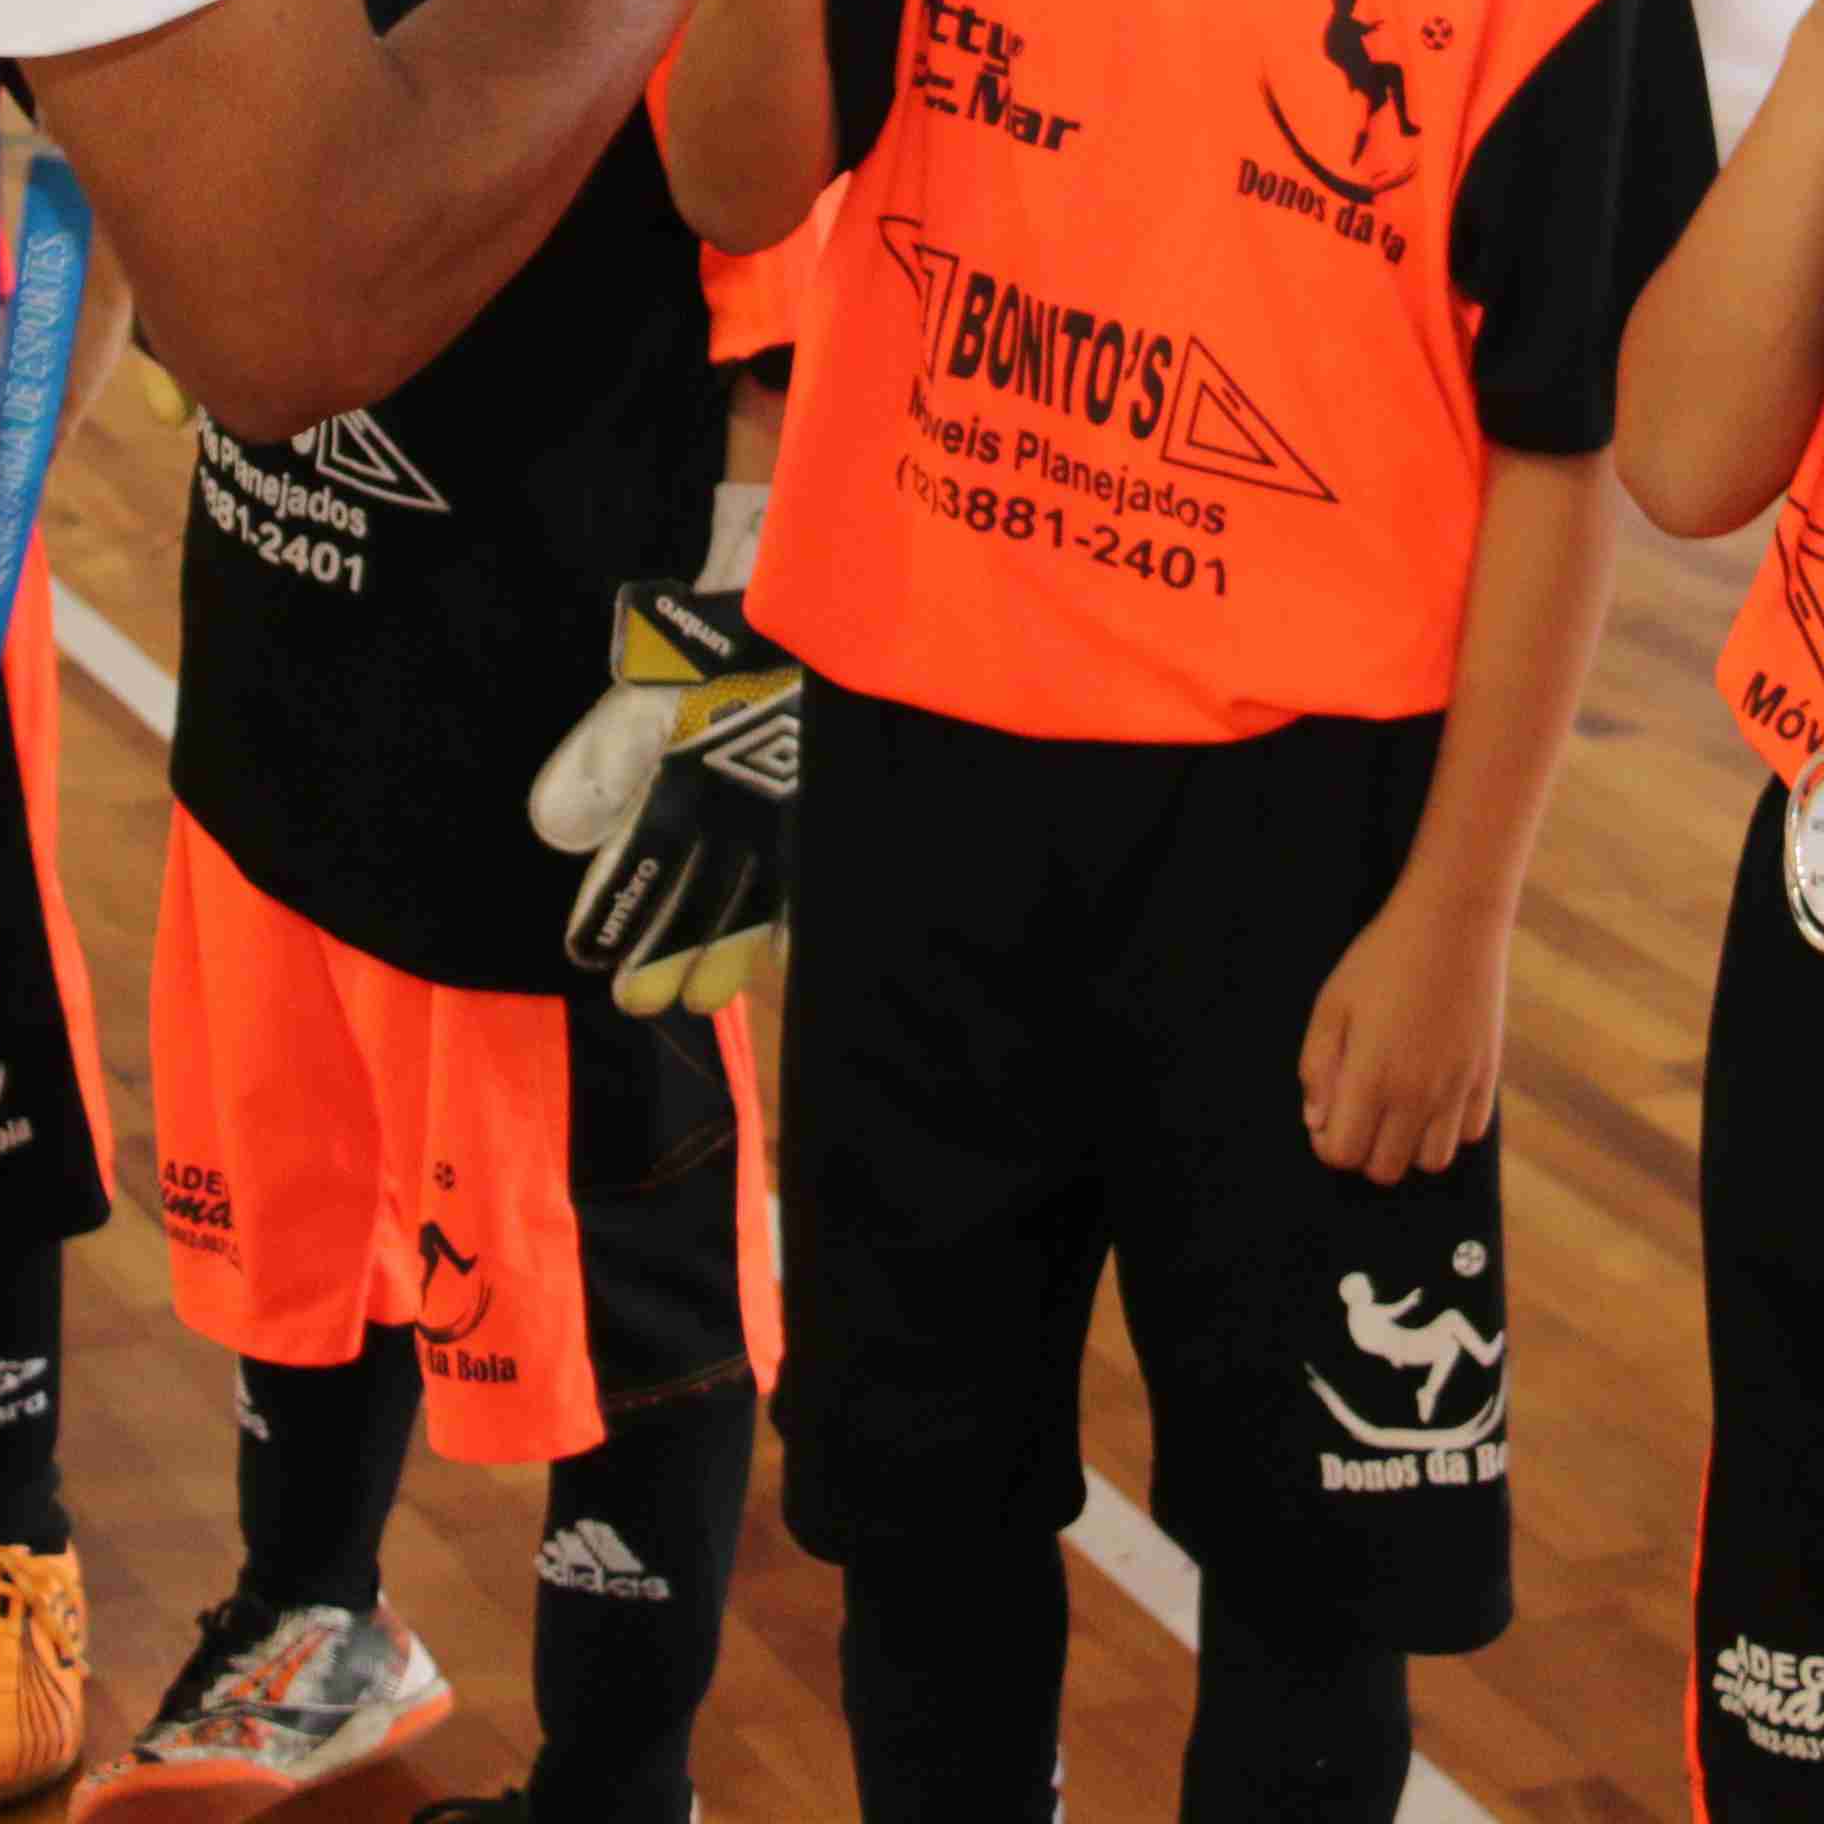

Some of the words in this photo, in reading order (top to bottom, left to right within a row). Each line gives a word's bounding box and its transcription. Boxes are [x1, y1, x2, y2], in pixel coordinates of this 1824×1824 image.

[966, 72, 1081, 152] Mar
[947, 271, 1174, 441] BONITO'S
[1014, 428, 1228, 536] Planejados
[1319, 1450, 1420, 1493] Donos
[1425, 1448, 1470, 1485] da
